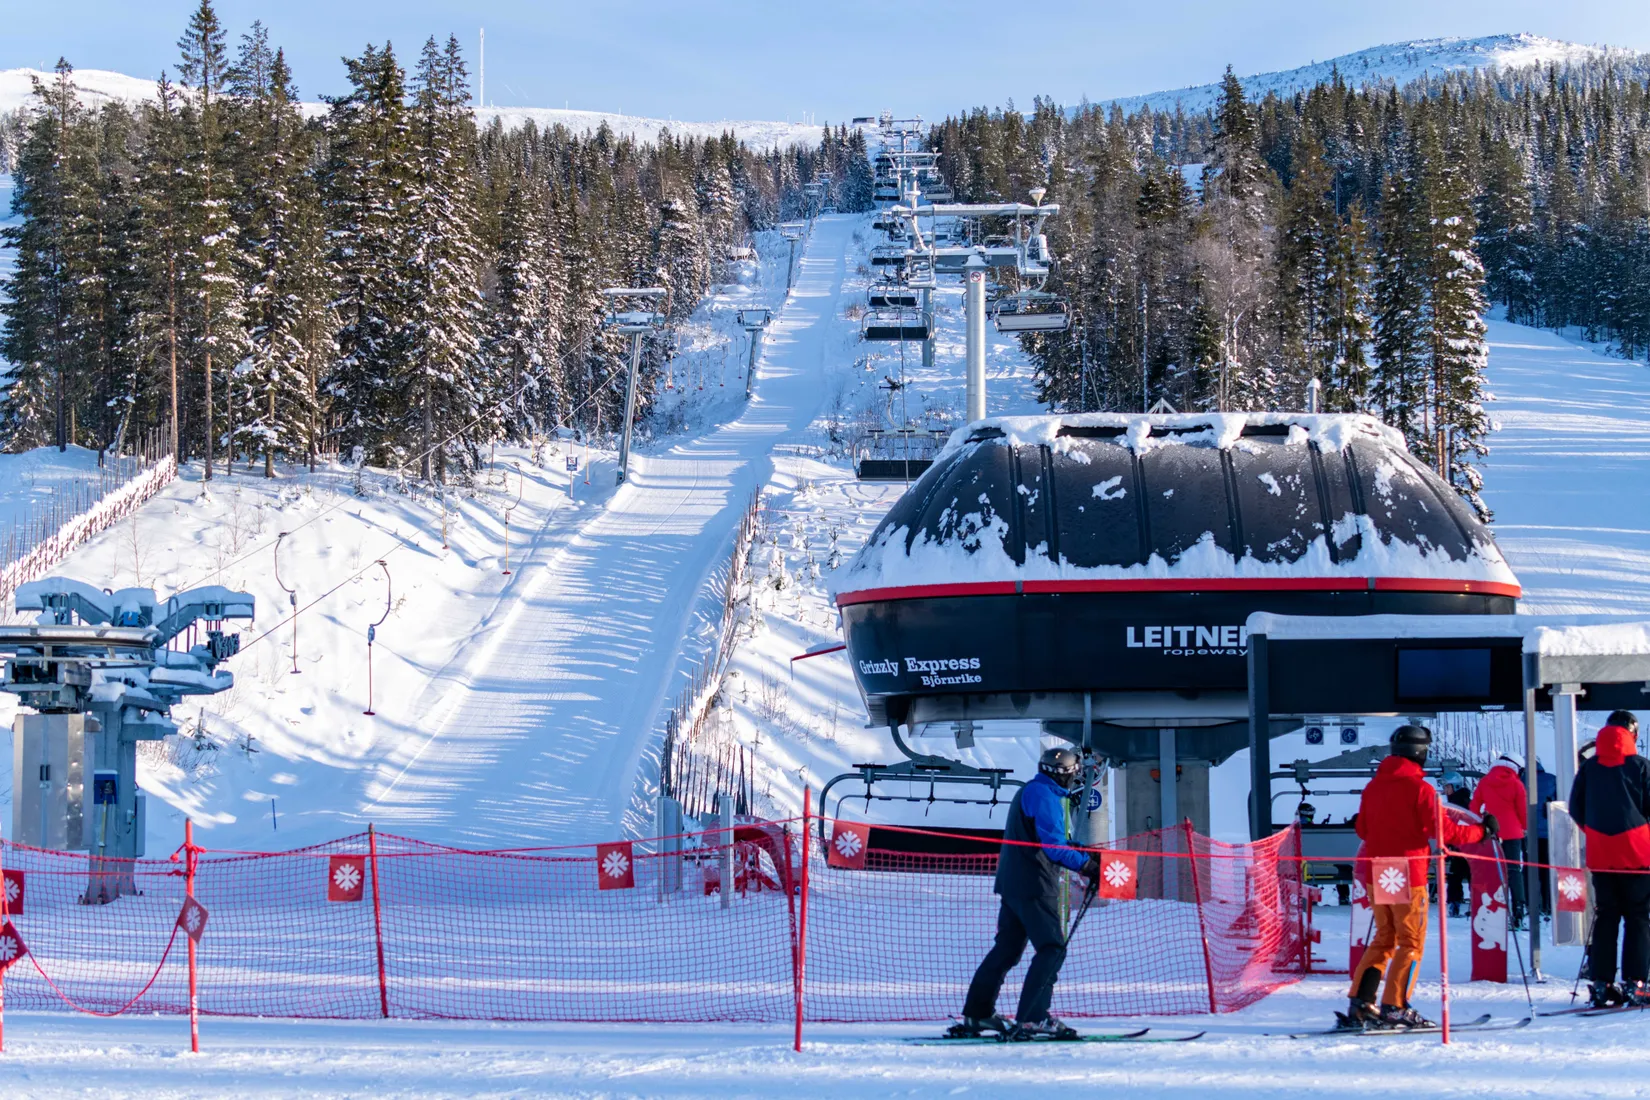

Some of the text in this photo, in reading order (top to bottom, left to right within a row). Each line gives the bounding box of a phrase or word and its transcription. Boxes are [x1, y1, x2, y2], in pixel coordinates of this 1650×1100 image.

[859, 657, 980, 676] Grizzly Express
[921, 674, 981, 687] Björnrike
